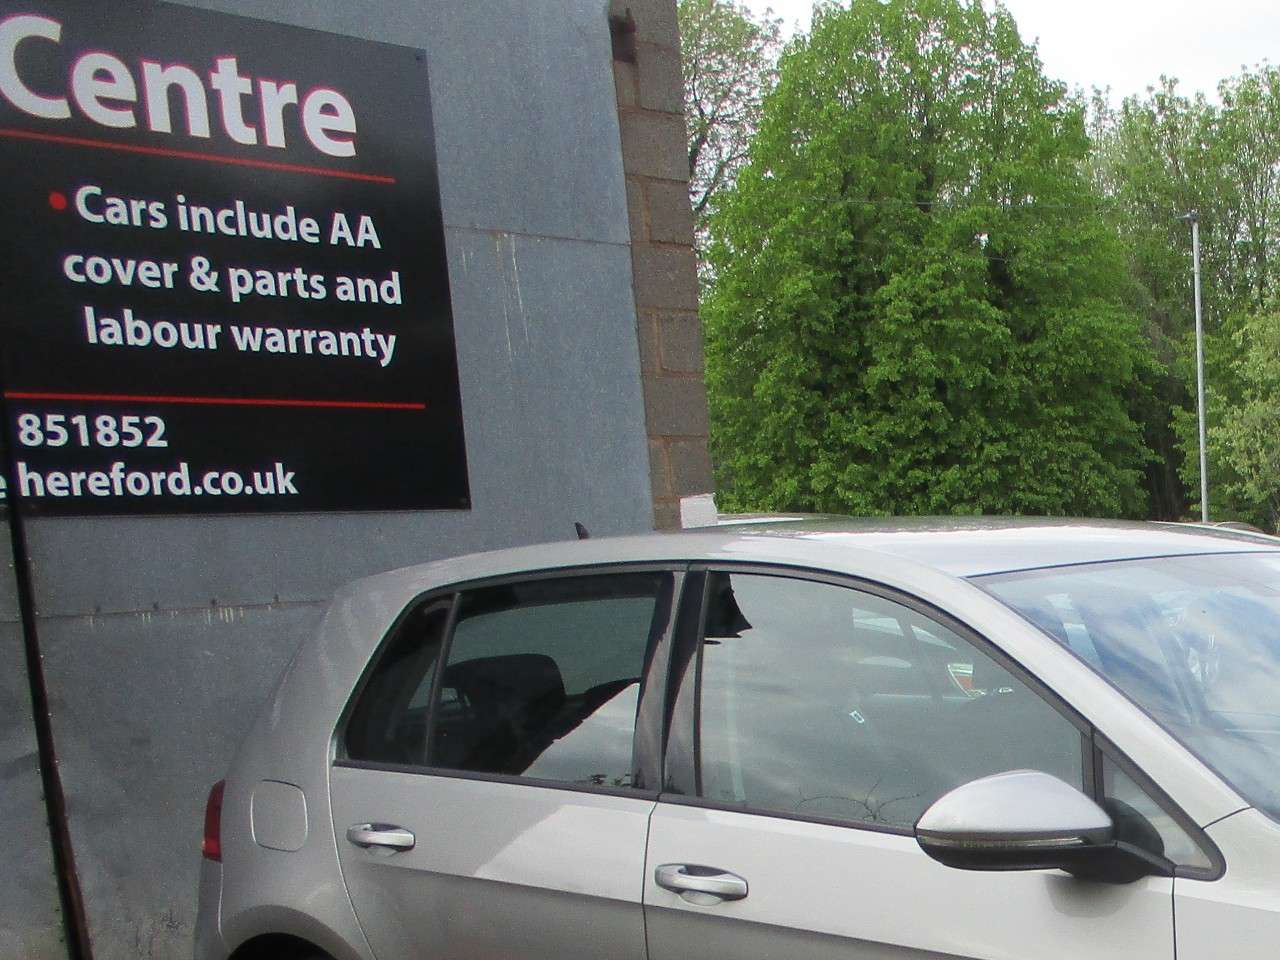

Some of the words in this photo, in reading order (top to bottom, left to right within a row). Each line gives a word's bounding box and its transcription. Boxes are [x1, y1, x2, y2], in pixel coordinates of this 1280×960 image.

[0, 15, 356, 157] Centre
[75, 186, 168, 229] Cars
[177, 195, 320, 244] include
[330, 214, 382, 249] AA
[63, 254, 177, 289] cover
[189, 256, 220, 293] &
[229, 267, 326, 302] parts
[336, 272, 403, 305] and
[84, 306, 221, 350] labour
[231, 322, 397, 367] warranty
[18, 413, 168, 447] 851852
[17, 461, 299, 497] hereford.co.uk
